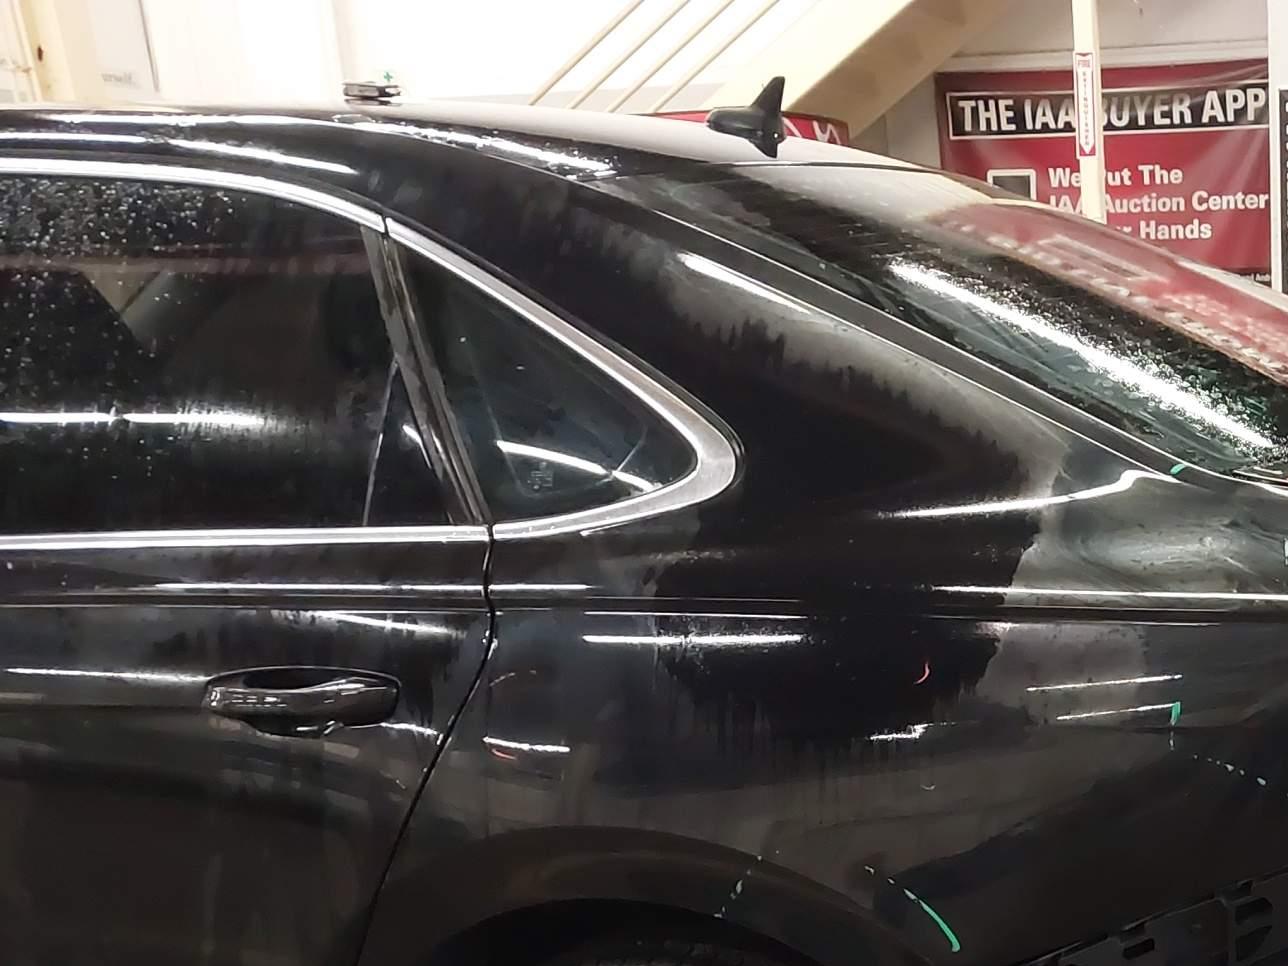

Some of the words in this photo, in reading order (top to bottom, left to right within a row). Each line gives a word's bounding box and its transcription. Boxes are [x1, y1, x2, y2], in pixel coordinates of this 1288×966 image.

[958, 99, 1015, 132] THE
[1024, 98, 1076, 130] IAA
[1201, 87, 1267, 124] APP
[1048, 167, 1081, 188] We
[1103, 167, 1132, 186] ut
[1138, 164, 1184, 186] The
[1192, 190, 1269, 212] Center
[1139, 219, 1213, 240] Hands
